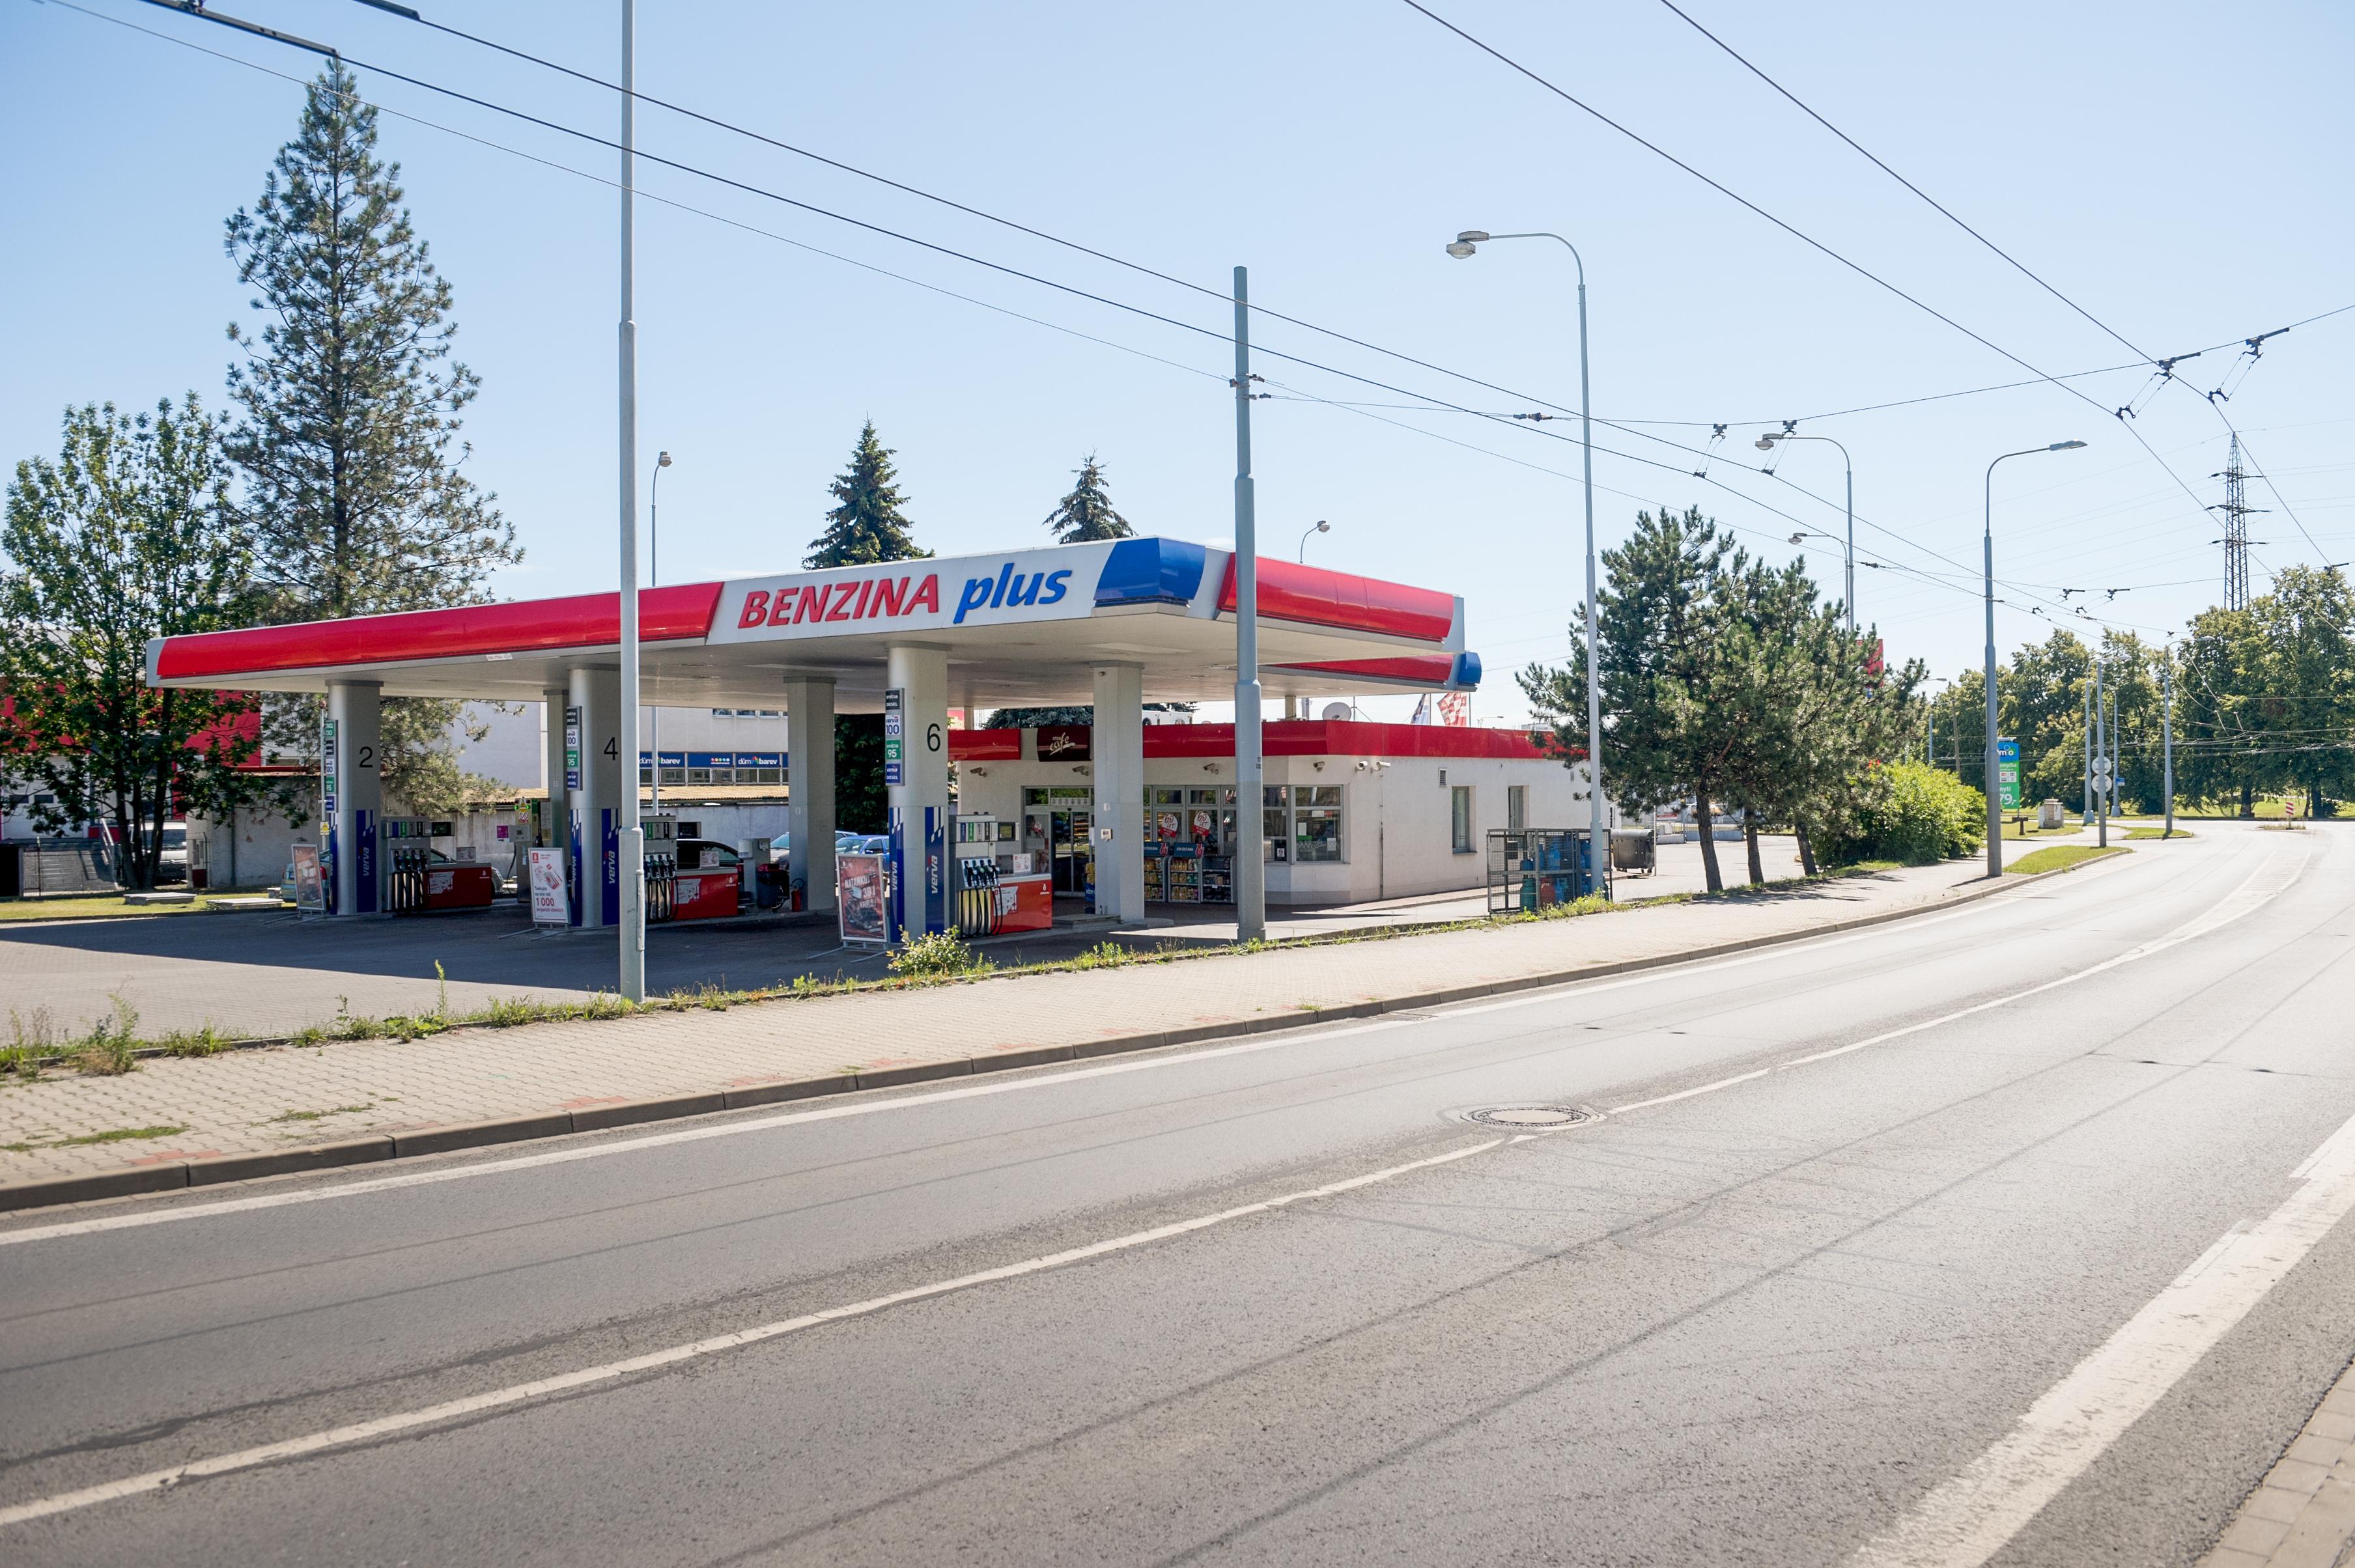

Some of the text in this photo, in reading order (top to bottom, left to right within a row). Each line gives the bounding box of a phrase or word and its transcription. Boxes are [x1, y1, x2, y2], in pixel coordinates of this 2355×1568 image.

[737, 563, 1073, 629] BENZINA plus
[886, 724, 899, 735] 100
[927, 723, 941, 752] 6
[359, 746, 373, 768] 2
[604, 736, 618, 761] 4
[887, 749, 897, 758] 95
[567, 758, 575, 766] 95
